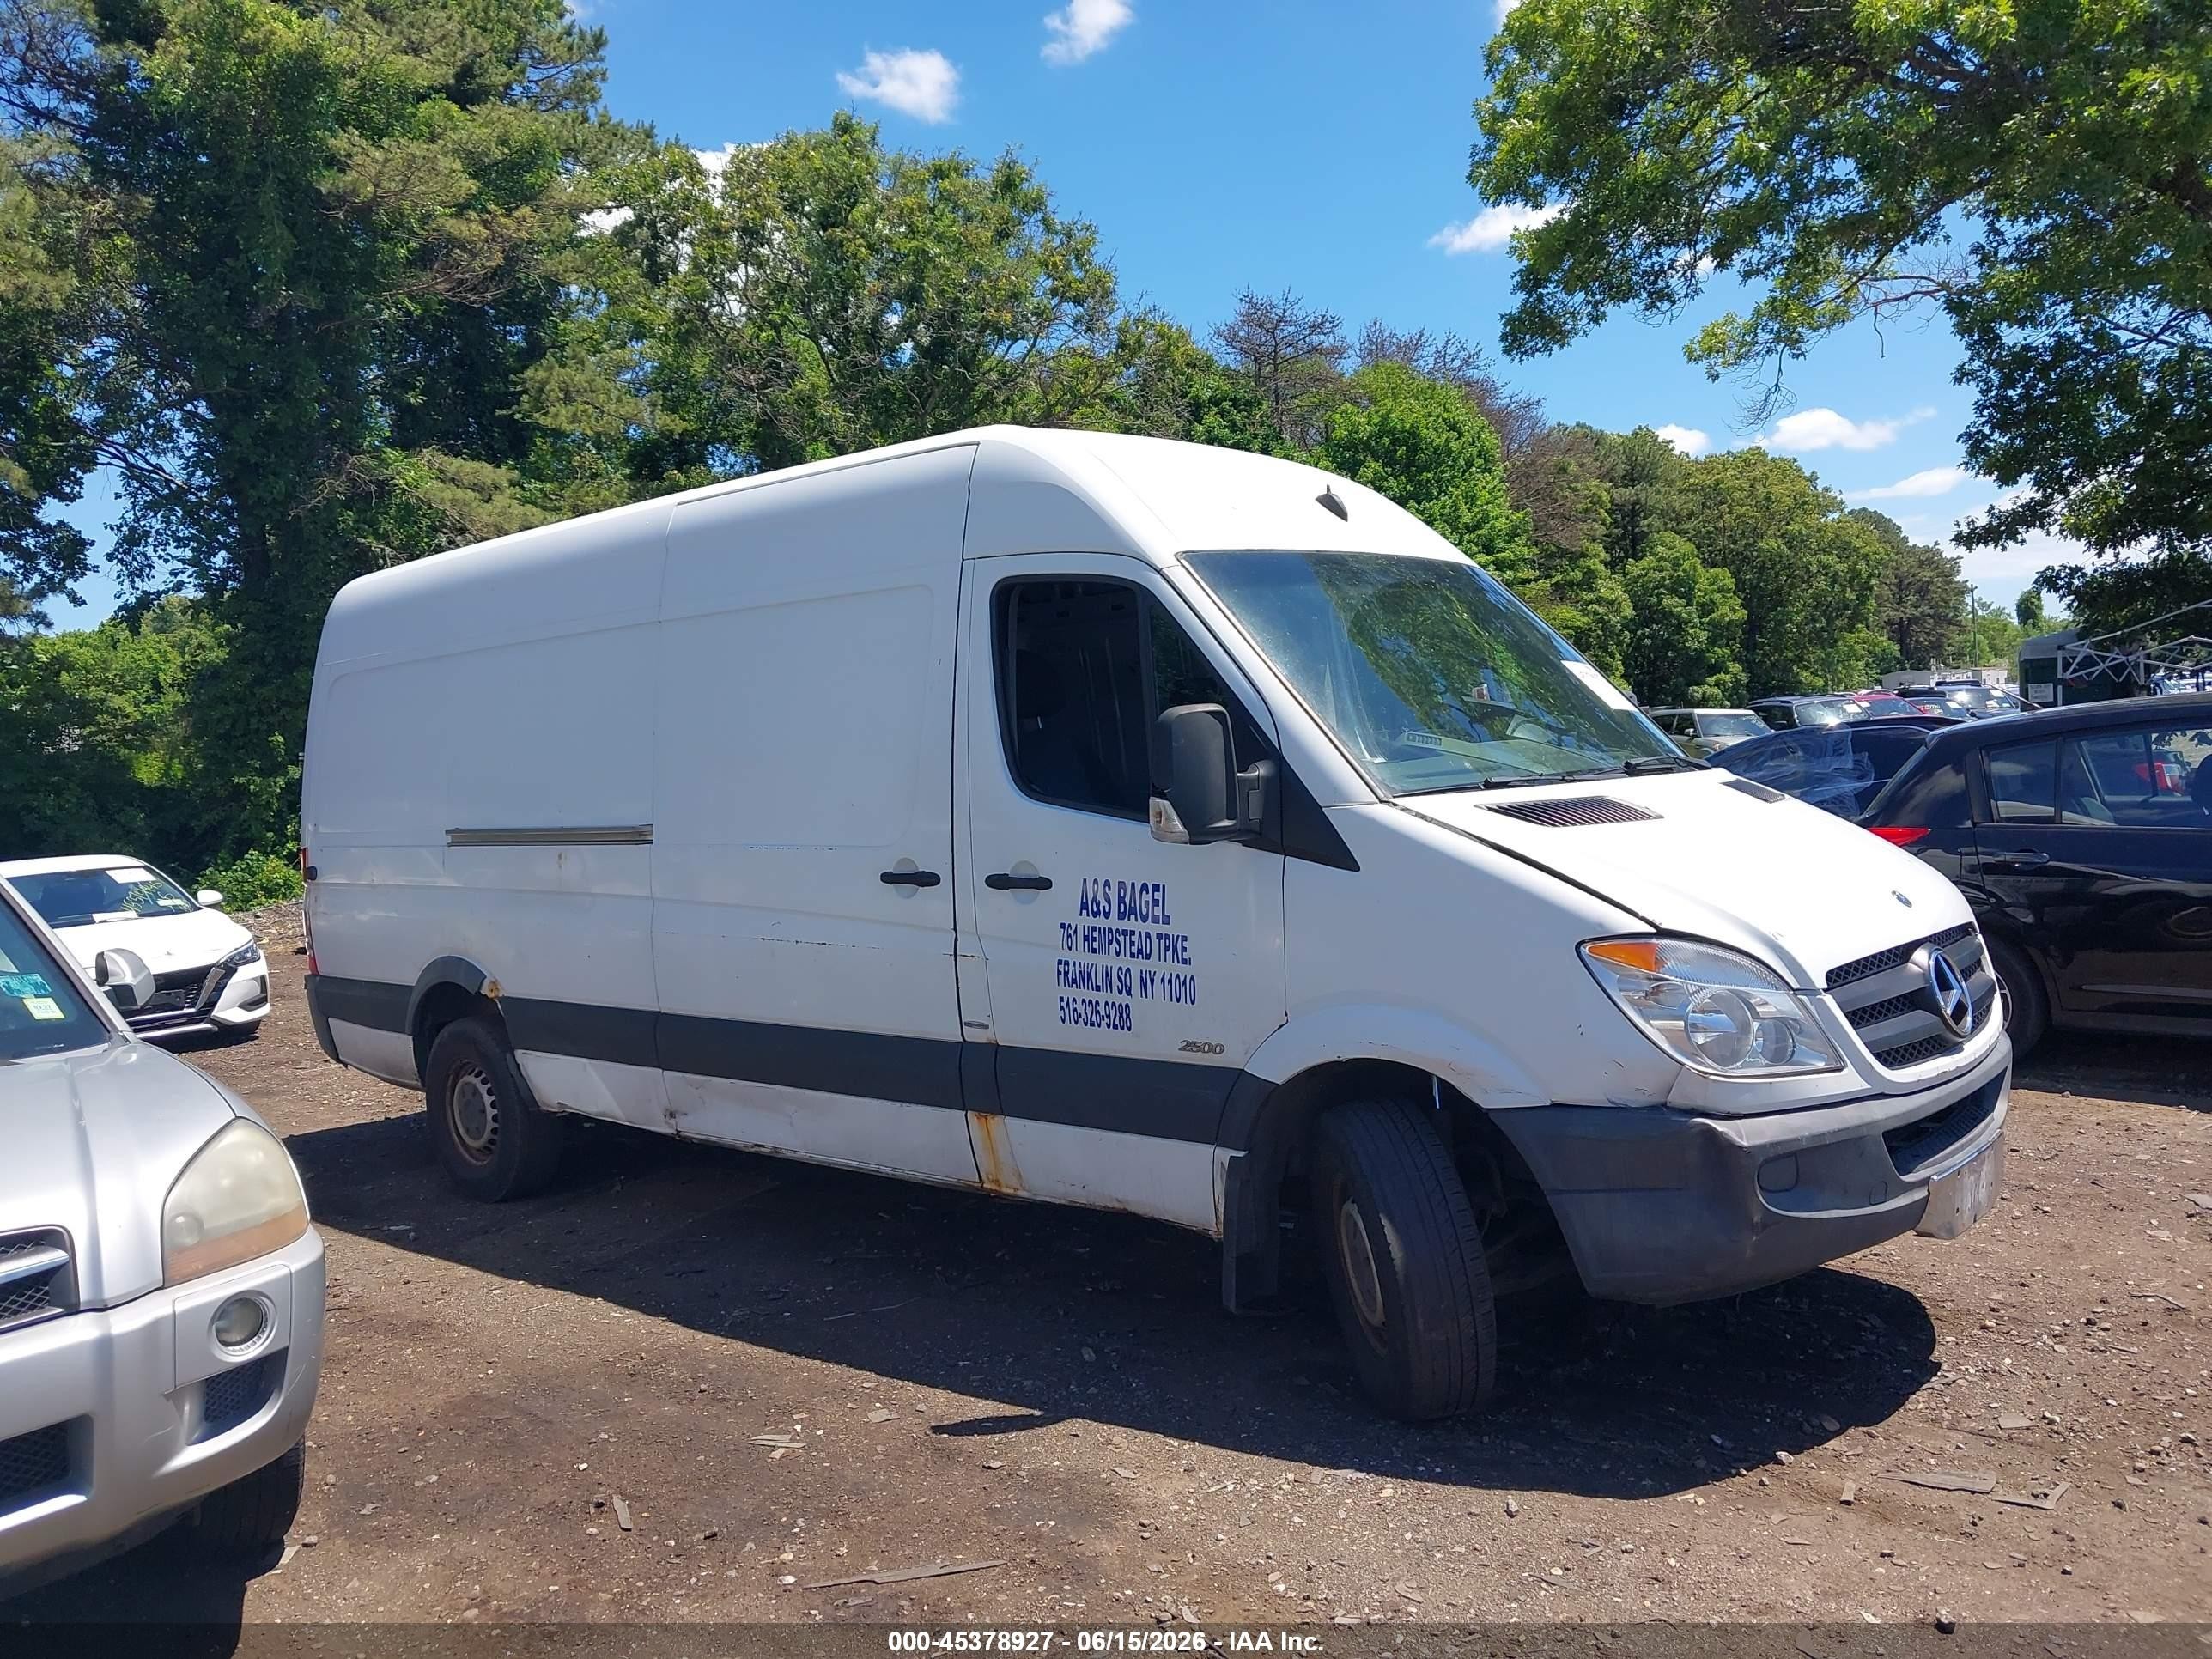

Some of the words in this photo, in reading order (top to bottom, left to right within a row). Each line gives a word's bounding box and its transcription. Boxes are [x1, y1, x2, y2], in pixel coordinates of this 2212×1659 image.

[1079, 878, 1112, 920] A&S
[1117, 880, 1170, 926] BAGEL
[1060, 922, 1079, 951] 761
[1083, 925, 1152, 960] HEMPSTEAD
[1156, 932, 1192, 966] TPKE.
[1057, 959, 1113, 994] FRANKLIN
[1116, 966, 1133, 999] SQ
[1139, 969, 1157, 1000] NY
[1160, 971, 1196, 1006] 11010
[1059, 996, 1132, 1032] 516-326-9288
[1178, 1040, 1225, 1055] 2500
